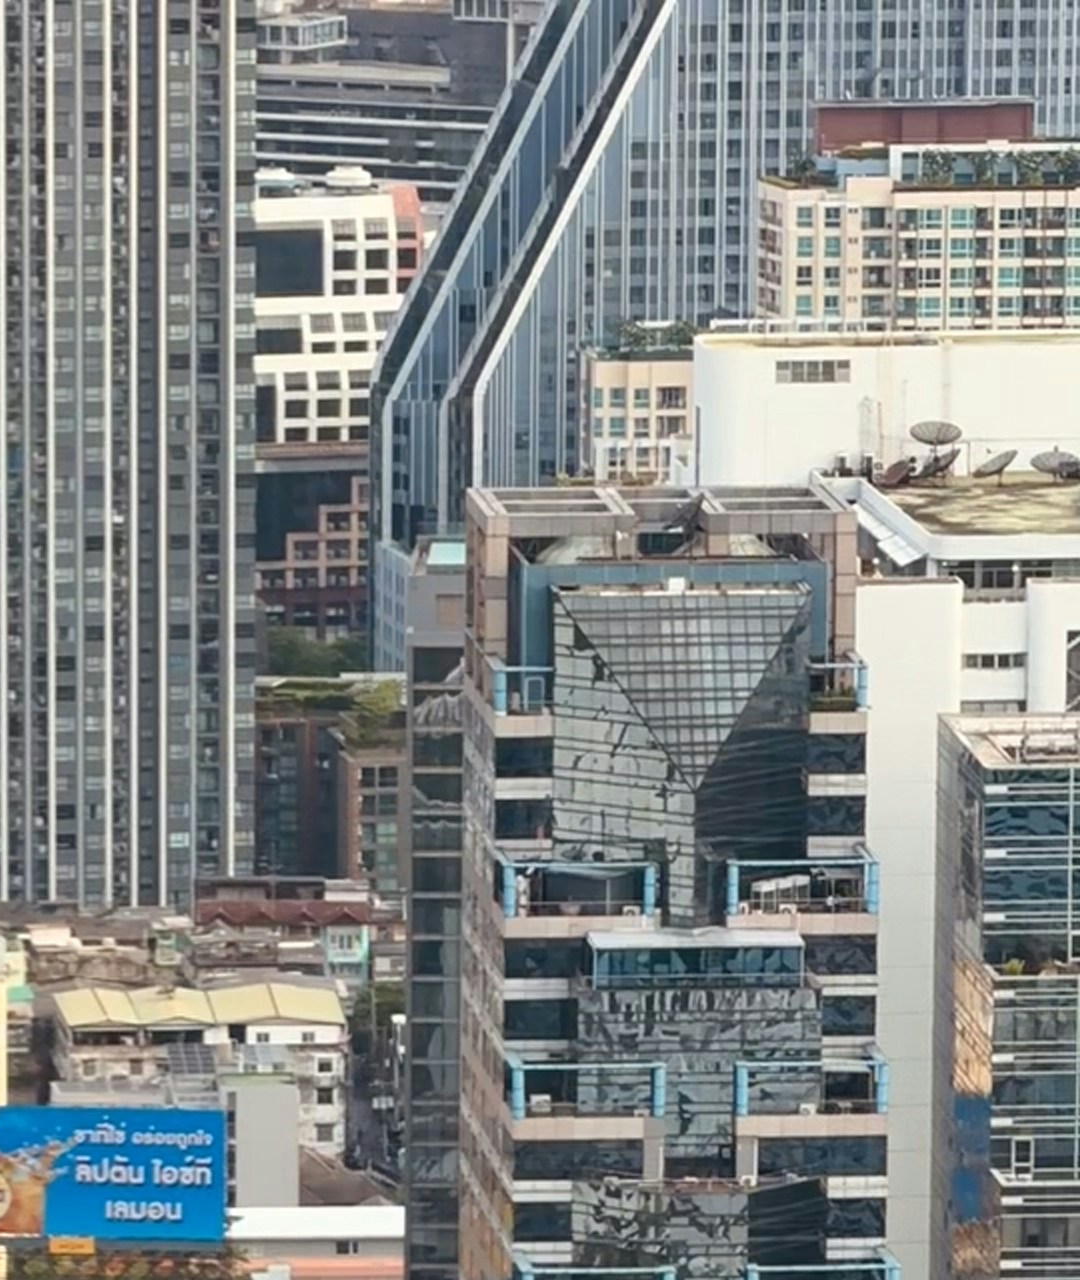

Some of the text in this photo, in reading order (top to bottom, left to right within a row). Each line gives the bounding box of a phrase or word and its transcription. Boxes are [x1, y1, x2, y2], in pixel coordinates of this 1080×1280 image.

[75, 1155, 145, 1184] ลิปตัน
[105, 1200, 183, 1222] เลมอน
